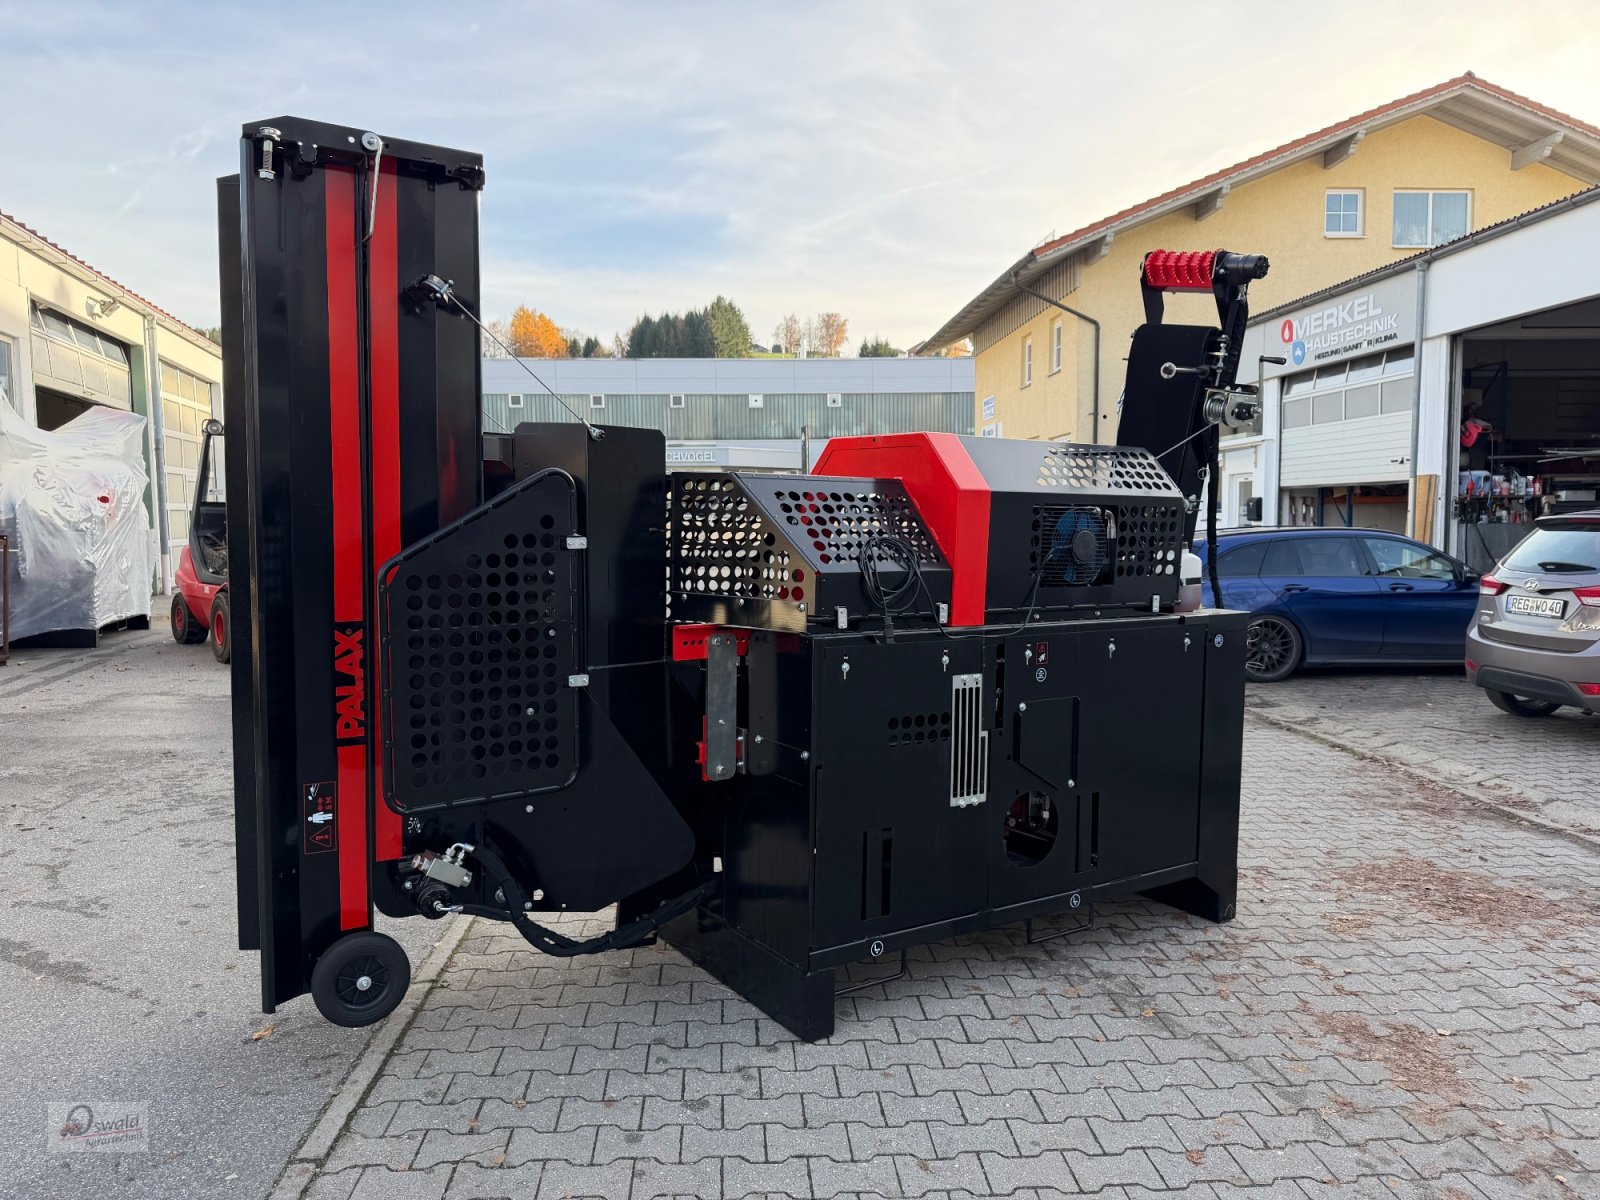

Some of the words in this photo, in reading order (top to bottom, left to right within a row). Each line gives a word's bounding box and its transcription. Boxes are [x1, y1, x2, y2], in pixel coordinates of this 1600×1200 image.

[1294, 294, 1382, 339] MERKEL
[1305, 314, 1398, 352] HAUSTECHNIK
[1512, 598, 1530, 610] REG
[1549, 602, 1561, 614] 40
[334, 629, 364, 739] PALAX
